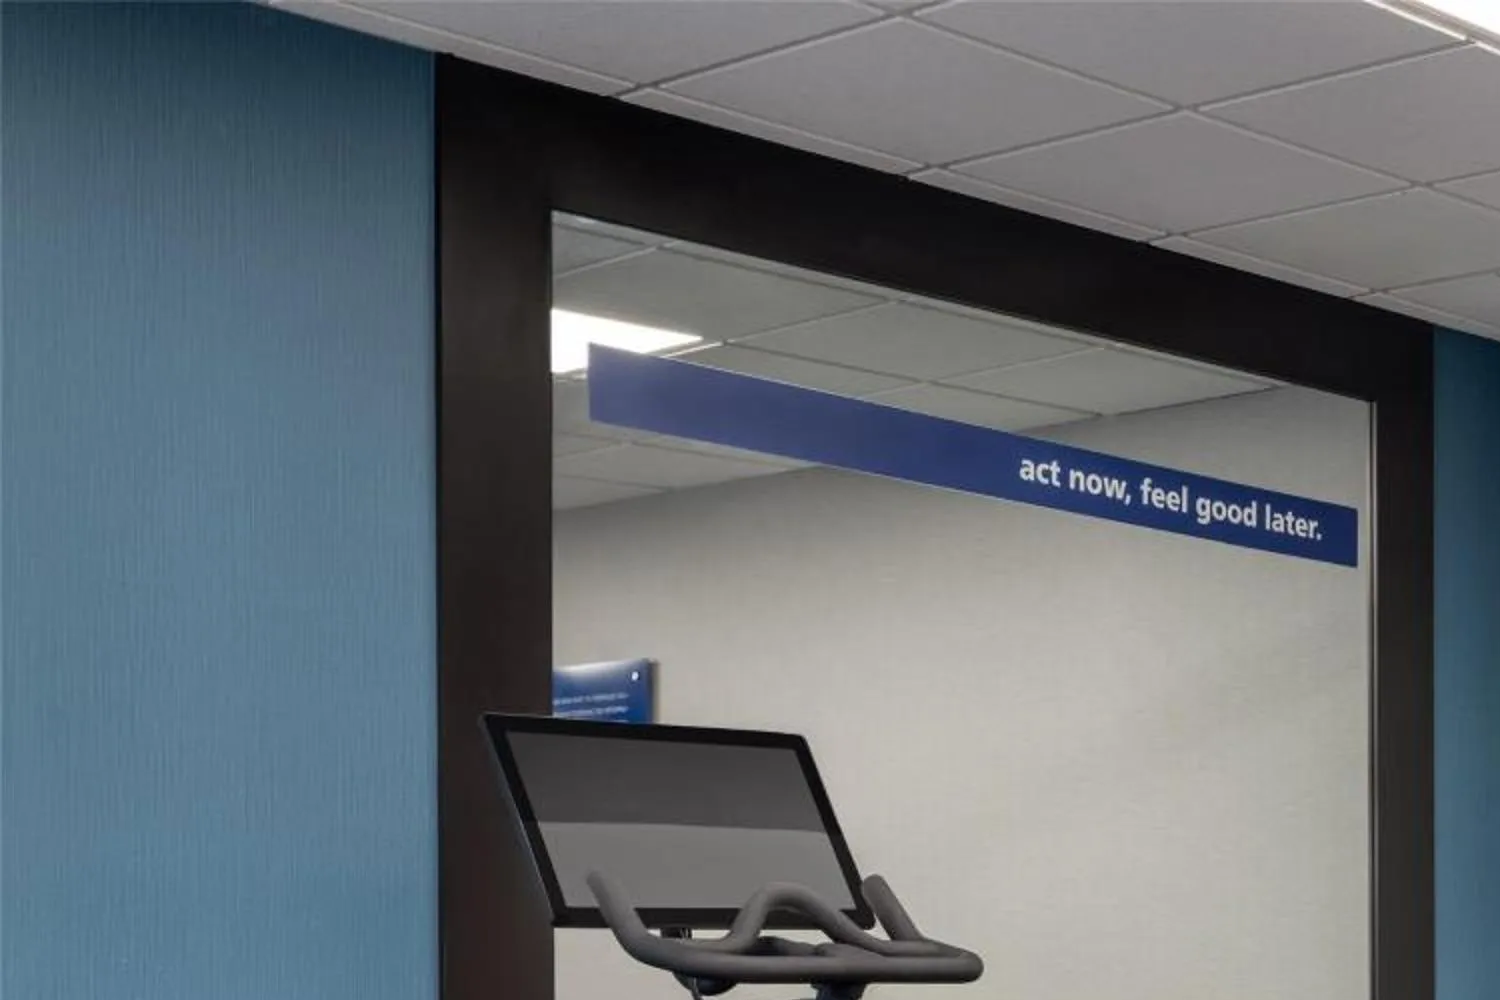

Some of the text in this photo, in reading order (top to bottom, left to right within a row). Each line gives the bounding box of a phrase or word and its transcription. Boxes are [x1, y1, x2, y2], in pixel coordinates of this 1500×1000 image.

[1019, 458, 1322, 541] act now, feel good later.
